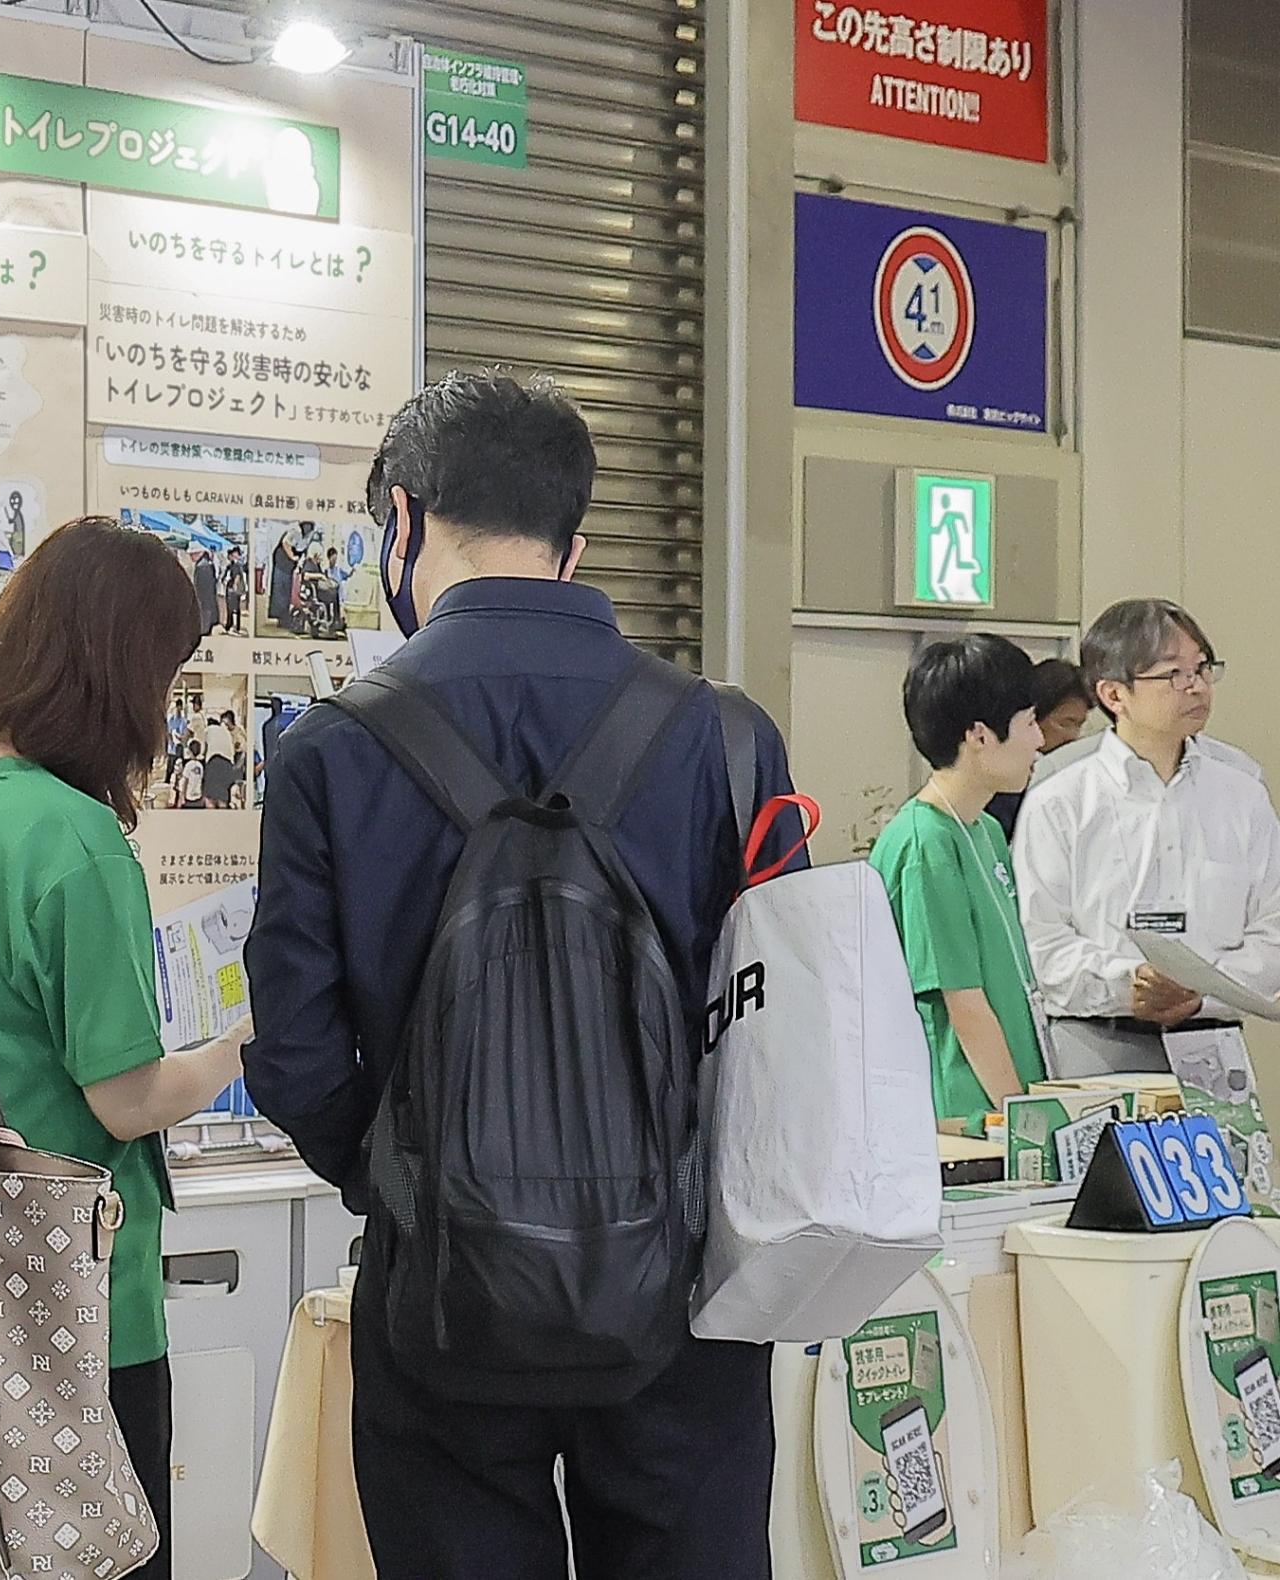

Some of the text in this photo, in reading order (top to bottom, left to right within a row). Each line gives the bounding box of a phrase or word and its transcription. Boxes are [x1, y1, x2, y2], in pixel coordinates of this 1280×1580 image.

[812, 1, 1032, 81] この先高さ制限あり
[426, 110, 516, 155] G14-40
[99, 302, 307, 342] 災害時のトイレ問題を解決するため
[96, 335, 371, 391] 「いのちを守る災害時の安心な
[195, 490, 244, 506] CARAVAN
[161, 854, 258, 866] さまざまな団体と協力し
[1129, 1133, 1242, 1218] 033
